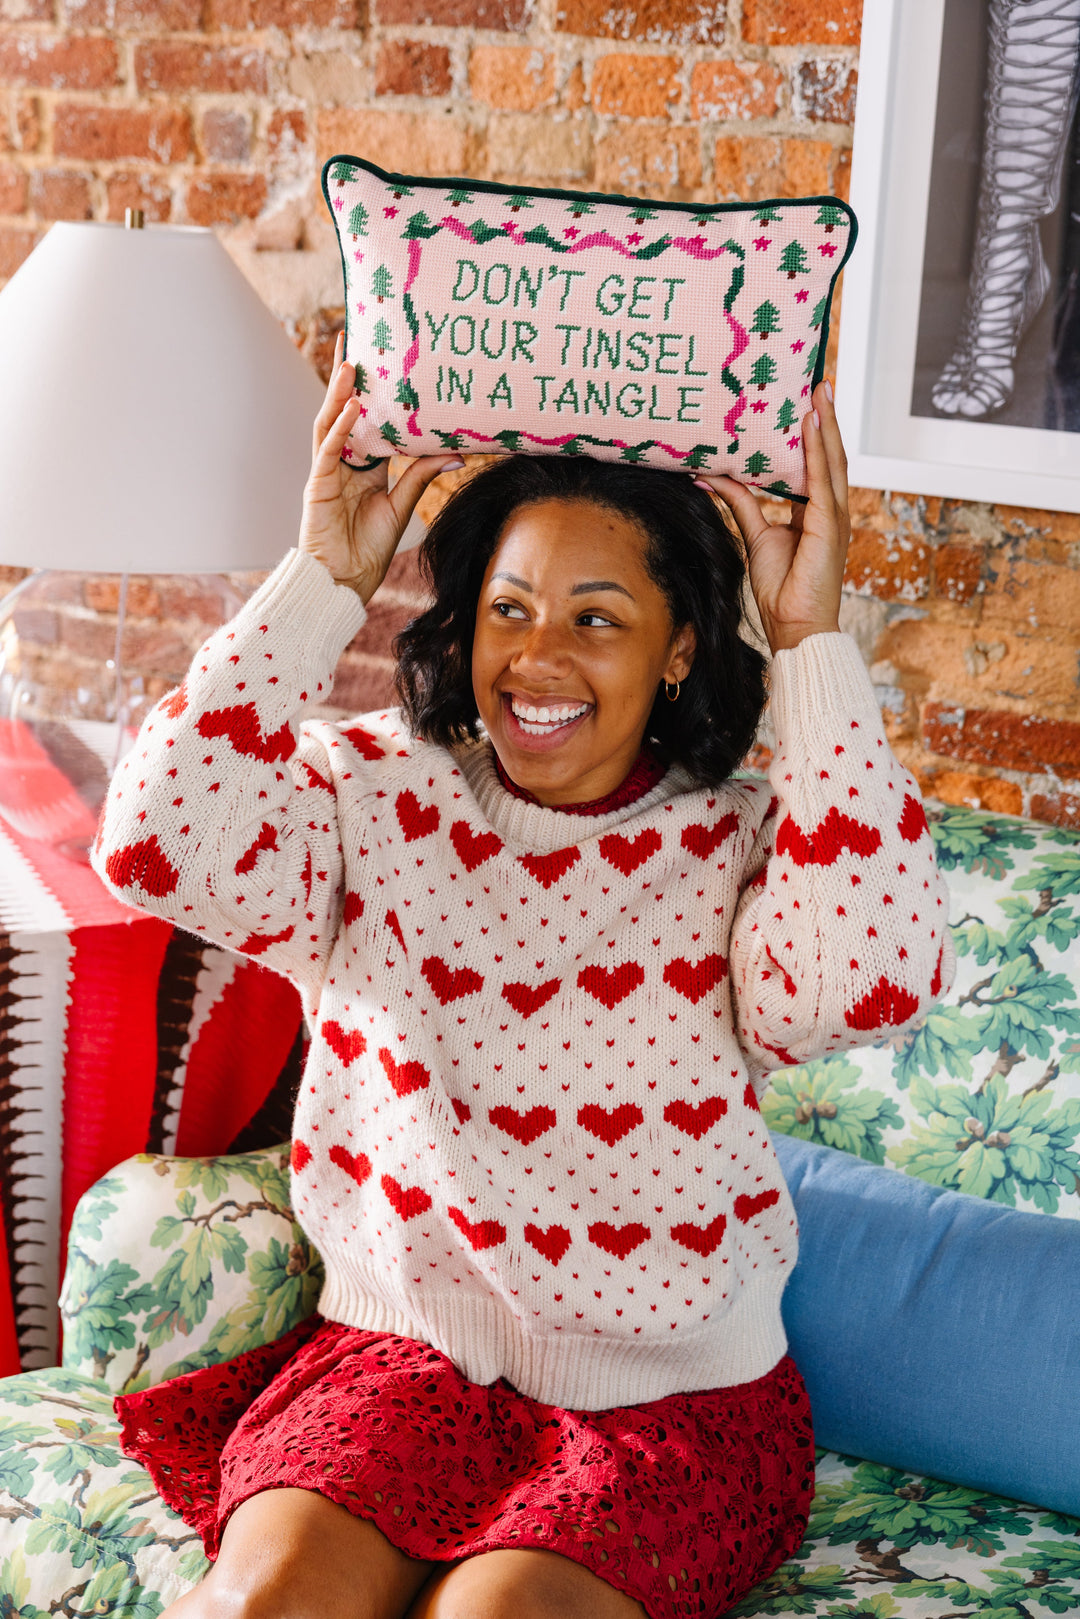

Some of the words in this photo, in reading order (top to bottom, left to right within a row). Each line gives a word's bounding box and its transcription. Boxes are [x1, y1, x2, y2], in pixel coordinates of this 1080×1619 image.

[452, 259, 585, 312] DON'T
[596, 274, 686, 320] GET
[425, 311, 538, 363] YOUR
[555, 324, 708, 377] TINSEL
[436, 365, 472, 405] IN
[487, 373, 512, 409] A
[533, 376, 704, 423] TANGLE
